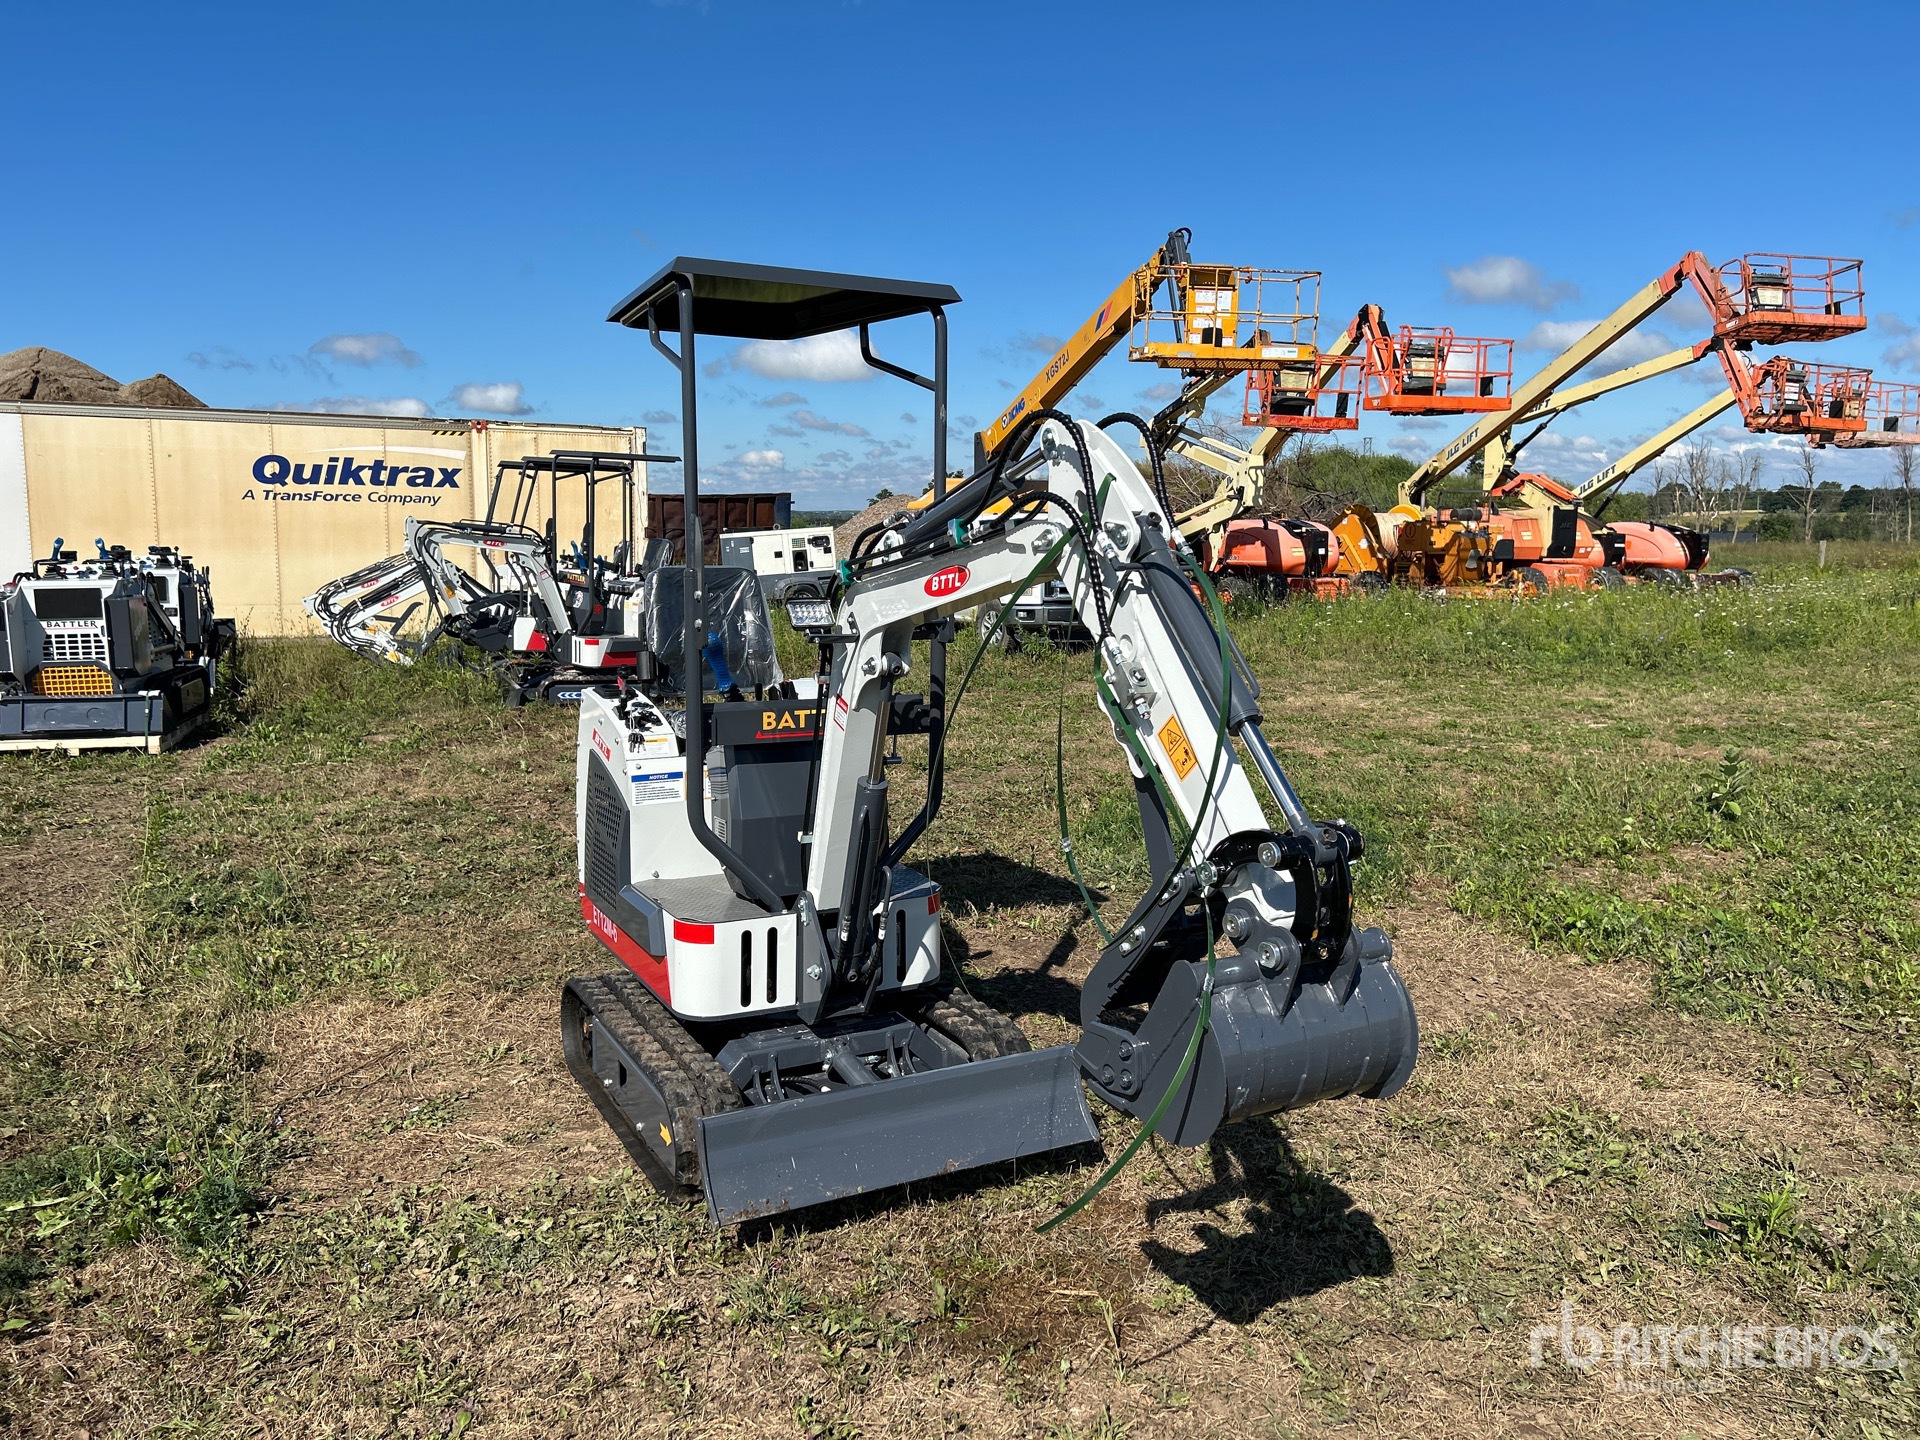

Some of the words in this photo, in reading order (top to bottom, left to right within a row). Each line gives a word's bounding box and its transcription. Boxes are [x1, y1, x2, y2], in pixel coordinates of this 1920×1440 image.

[1045, 349, 1070, 383] XGS72J
[1446, 442, 1460, 461] JLG
[1462, 427, 1479, 448] LIFT
[252, 454, 463, 488] Quiktrax
[1578, 479, 1594, 496] JLG
[1597, 464, 1616, 484] LIFT
[241, 490, 256, 501] A
[262, 489, 362, 503] TransForce
[367, 491, 442, 507] Company
[931, 572, 962, 592] BTTL
[46, 620, 98, 629] BATTLER
[594, 733, 609, 757] BTTL
